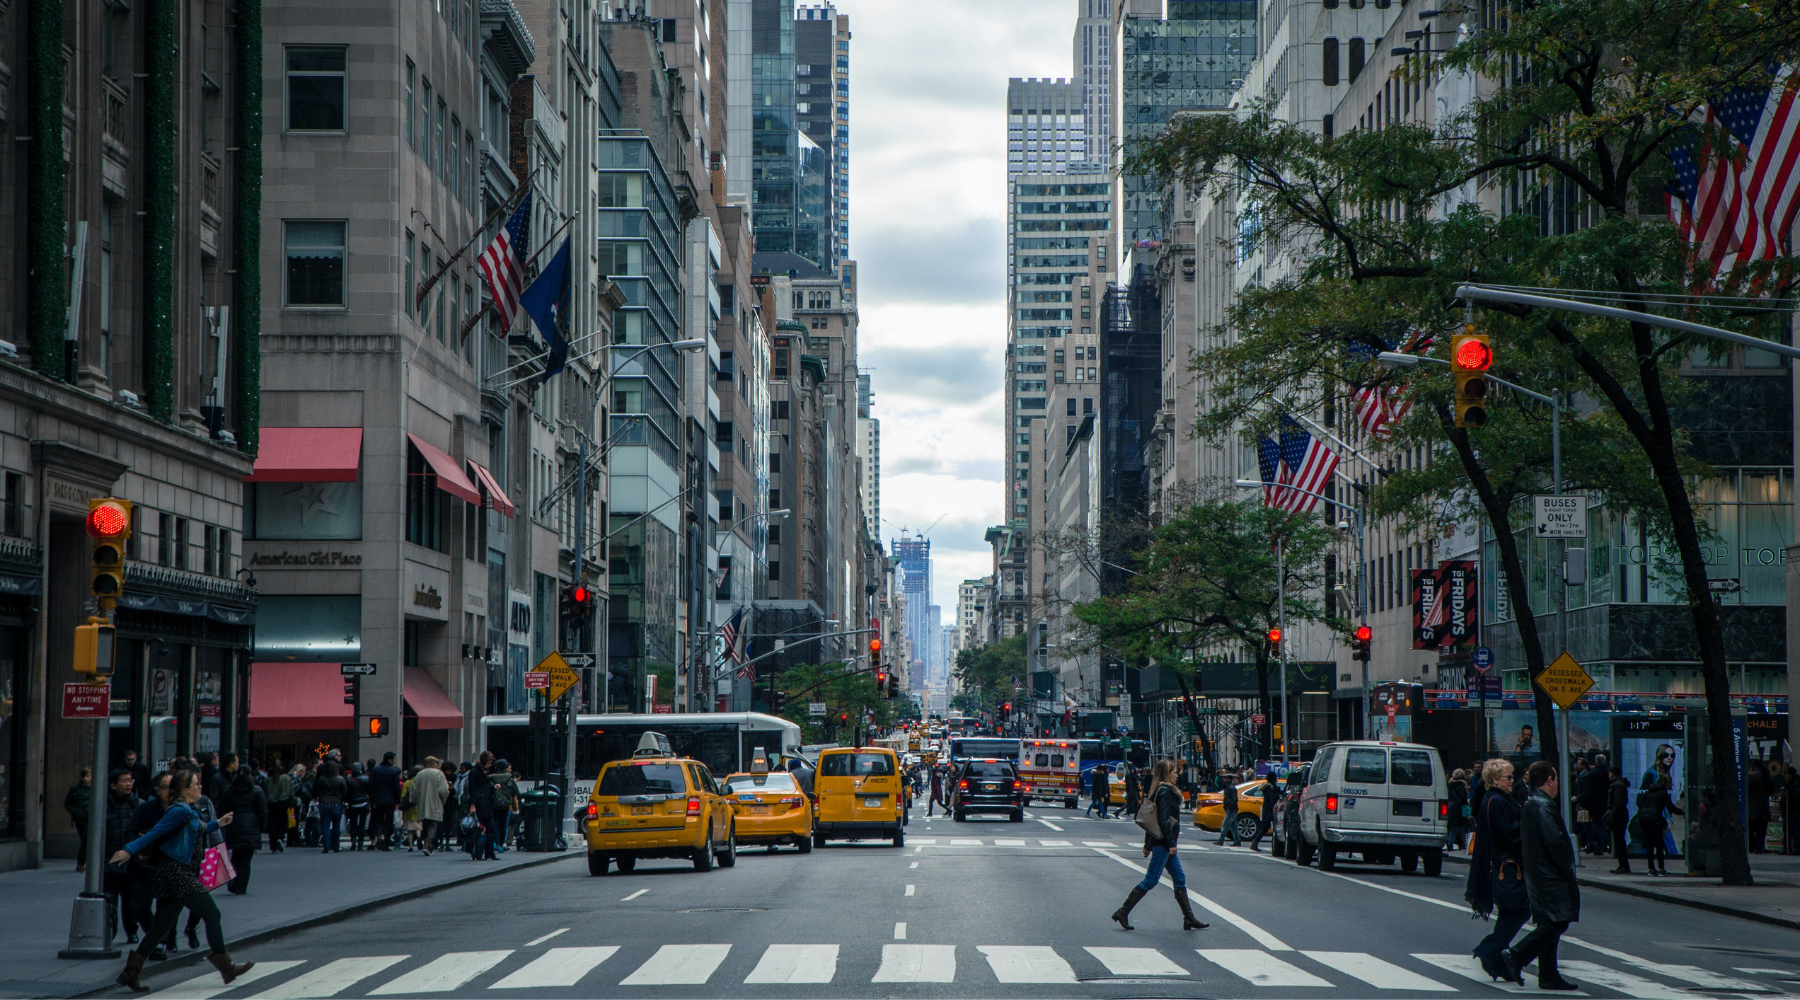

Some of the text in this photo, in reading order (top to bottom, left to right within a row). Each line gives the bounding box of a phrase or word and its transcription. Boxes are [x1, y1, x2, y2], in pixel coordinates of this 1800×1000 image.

[1544, 498, 1576, 507] BUSES
[250, 551, 362, 565] American Girl Place
[1613, 545, 1728, 565] TOPSOP
[510, 600, 530, 634] ALDO
[1422, 586, 1434, 640] FRIDYS
[1452, 578, 1465, 635] FRIDAYS
